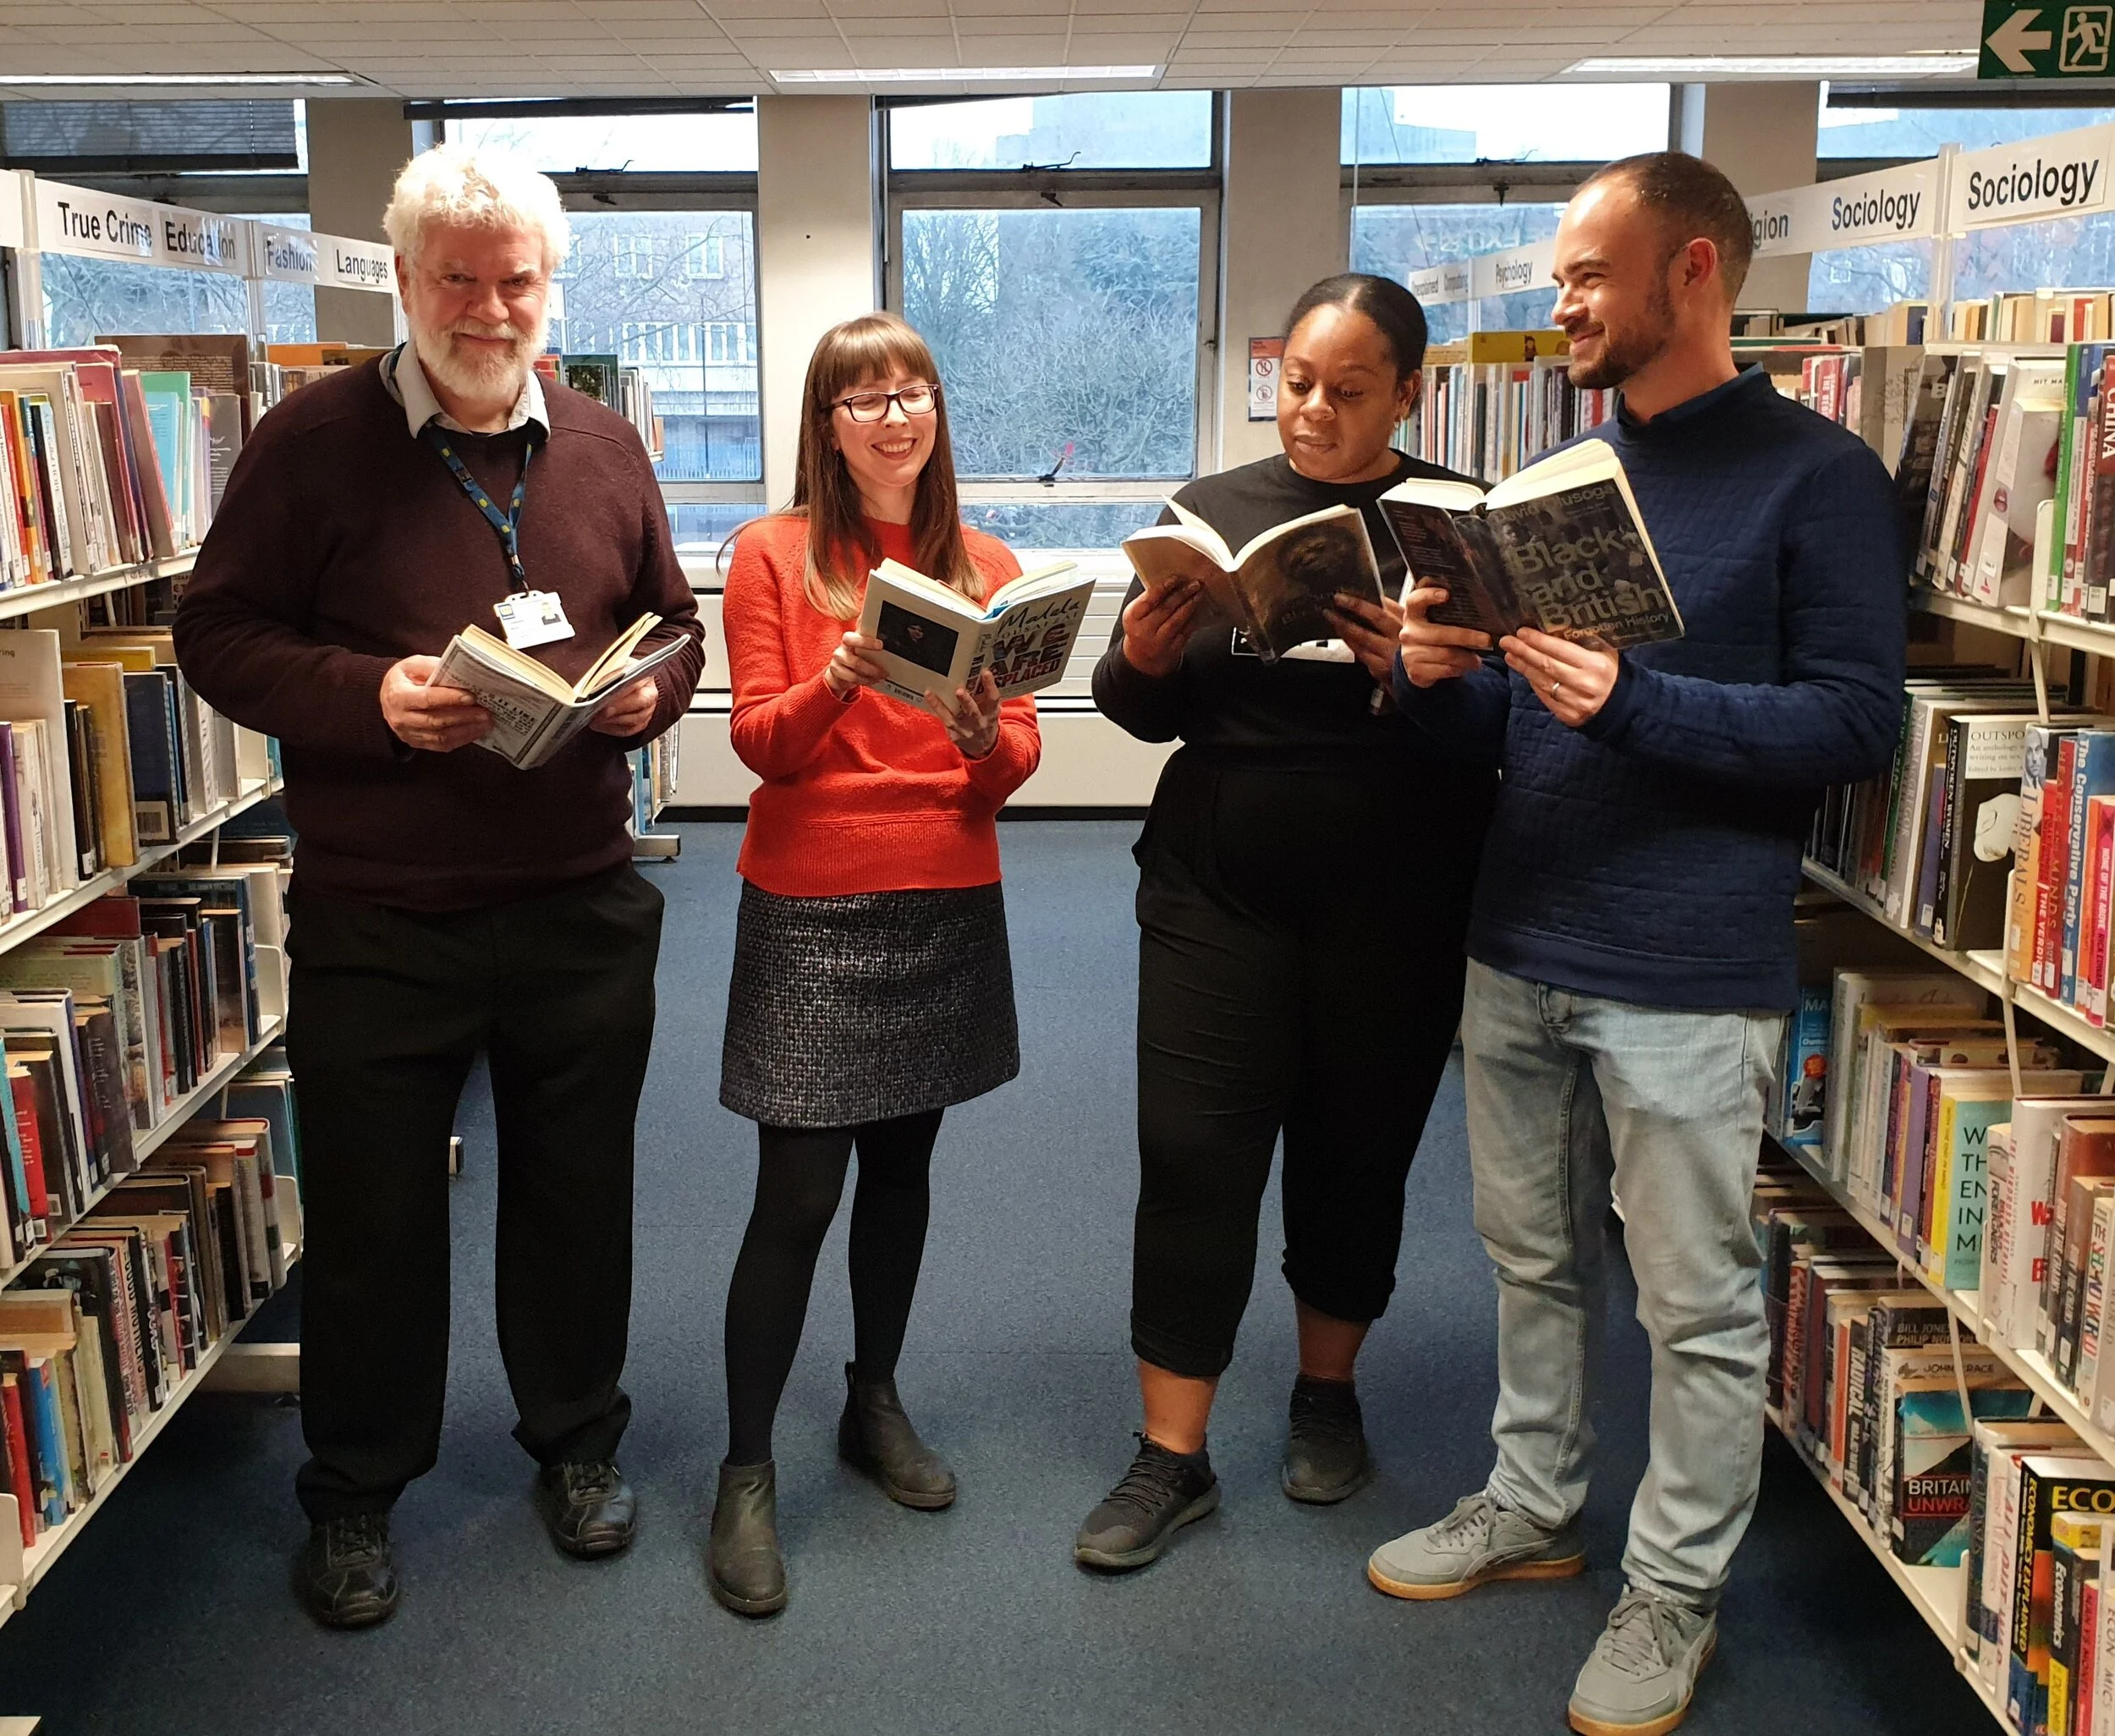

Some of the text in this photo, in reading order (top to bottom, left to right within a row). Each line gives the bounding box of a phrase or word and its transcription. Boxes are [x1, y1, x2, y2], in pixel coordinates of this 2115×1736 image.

[1968, 159, 2099, 211] Sociology
[58, 201, 153, 248] True Crime
[1832, 190, 1920, 230] Sociology
[165, 221, 236, 260] Education
[266, 240, 312, 272] Fashion
[337, 249, 388, 283] Languages
[1496, 260, 1533, 288] Psychology
[2101, 387, 2115, 459] CHINA
[1508, 525, 1626, 575] Black
[1524, 560, 1605, 606] and
[1535, 581, 1667, 634] British
[1625, 612, 1670, 627] History
[988, 641, 1068, 677] ARE
[992, 623, 1071, 661] WE
[993, 658, 1062, 689] SPLACED
[1970, 730, 2025, 742] OUTSPO
[1947, 728, 1958, 800] OUTSPOKEN
[1944, 804, 1953, 849] WOMEN
[2066, 739, 2090, 929] The Conservative Party
[2014, 792, 2039, 906] LIBERALS
[2101, 847, 2110, 871] NONE
[2048, 860, 2060, 929] MINDS
[2099, 886, 2108, 902] THE
[2101, 871, 2109, 886] OF
[2039, 893, 2048, 919] THE
[2098, 902, 2107, 931] ABOVE
[1990, 1179, 2000, 1266] FOREIGNERS
[2054, 1233, 2065, 1253] THE
[2051, 1252, 2063, 1295] CHAINS
[1897, 1334, 1926, 1344] PHILIP
[1898, 1323, 1918, 1334] BILL
[1849, 1347, 1866, 1417] RADICAL
[1923, 1364, 1994, 1374] JOHN RACE
[2019, 1477, 2038, 1652] ECONOMICS EXPLAINED
[2053, 1561, 2067, 1650] Economics
